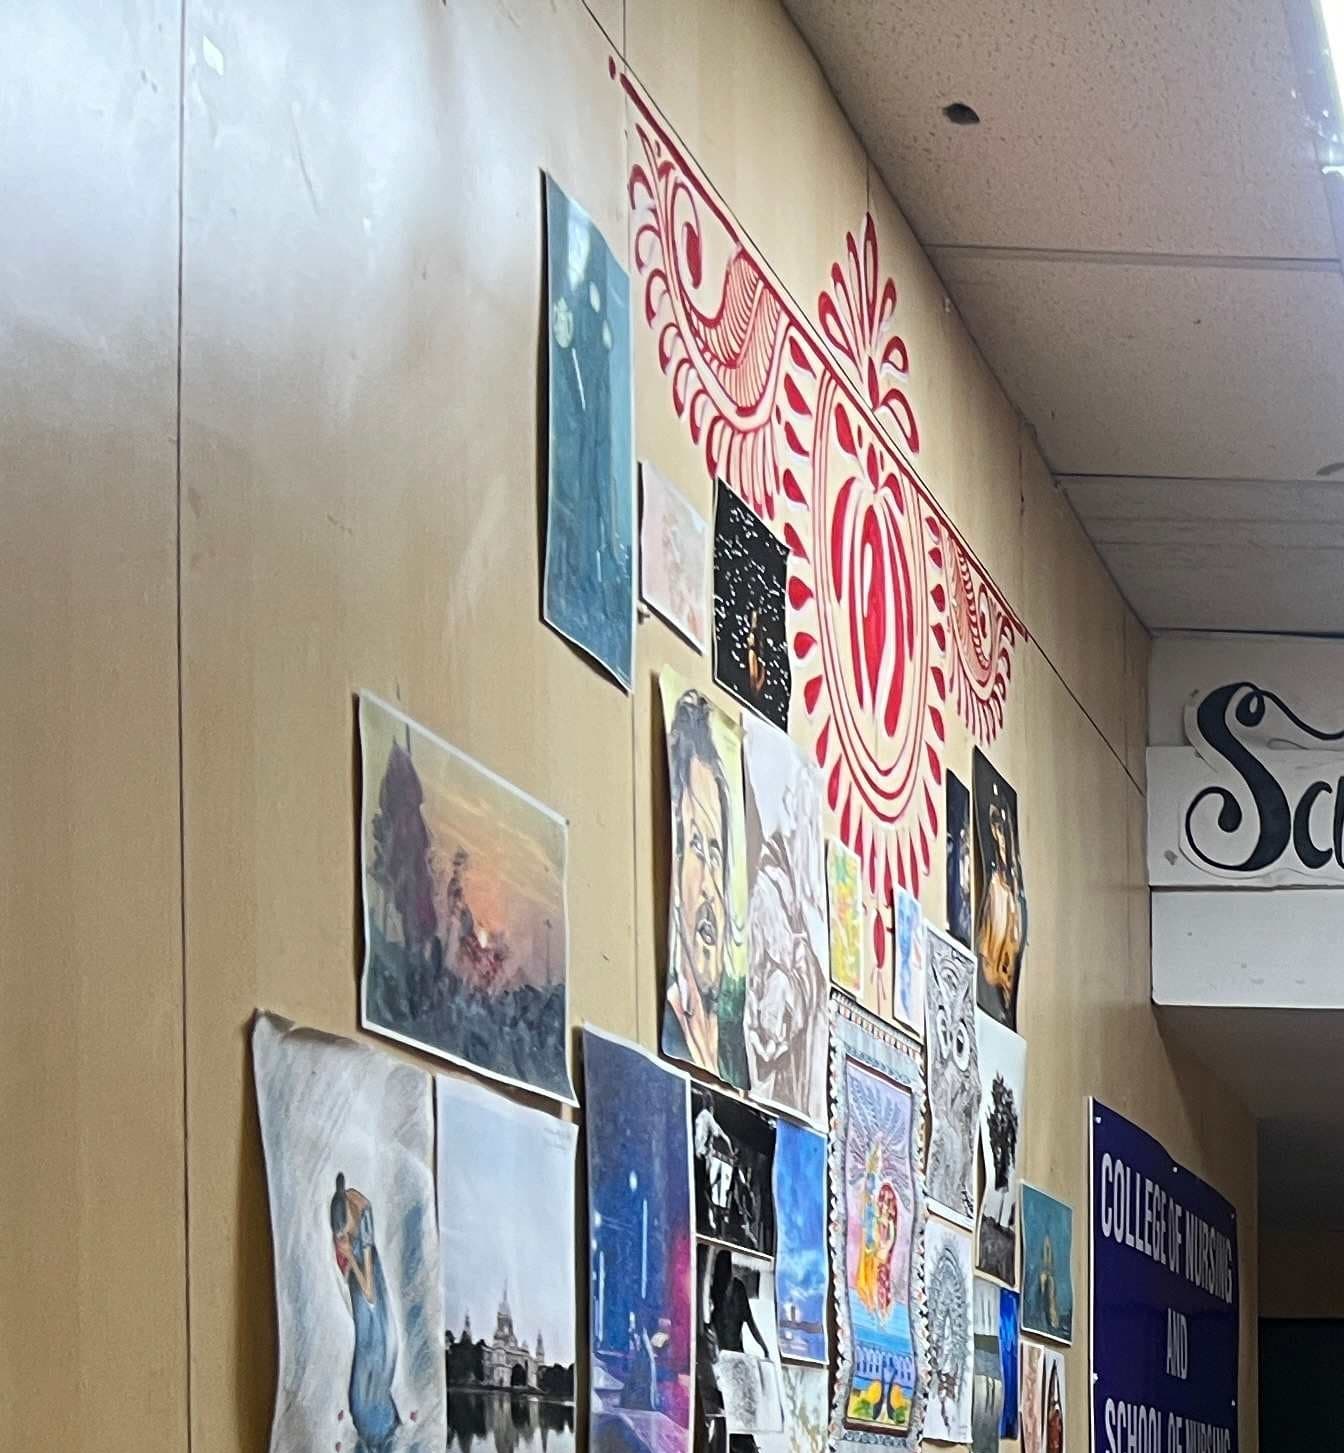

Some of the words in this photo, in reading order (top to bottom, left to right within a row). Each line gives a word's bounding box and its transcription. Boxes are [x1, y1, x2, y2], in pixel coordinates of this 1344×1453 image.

[1100, 1152, 1167, 1266] COLLEGE
[1167, 1196, 1183, 1274] OF
[1185, 1209, 1233, 1305] NURSING
[1166, 1307, 1189, 1381] AND
